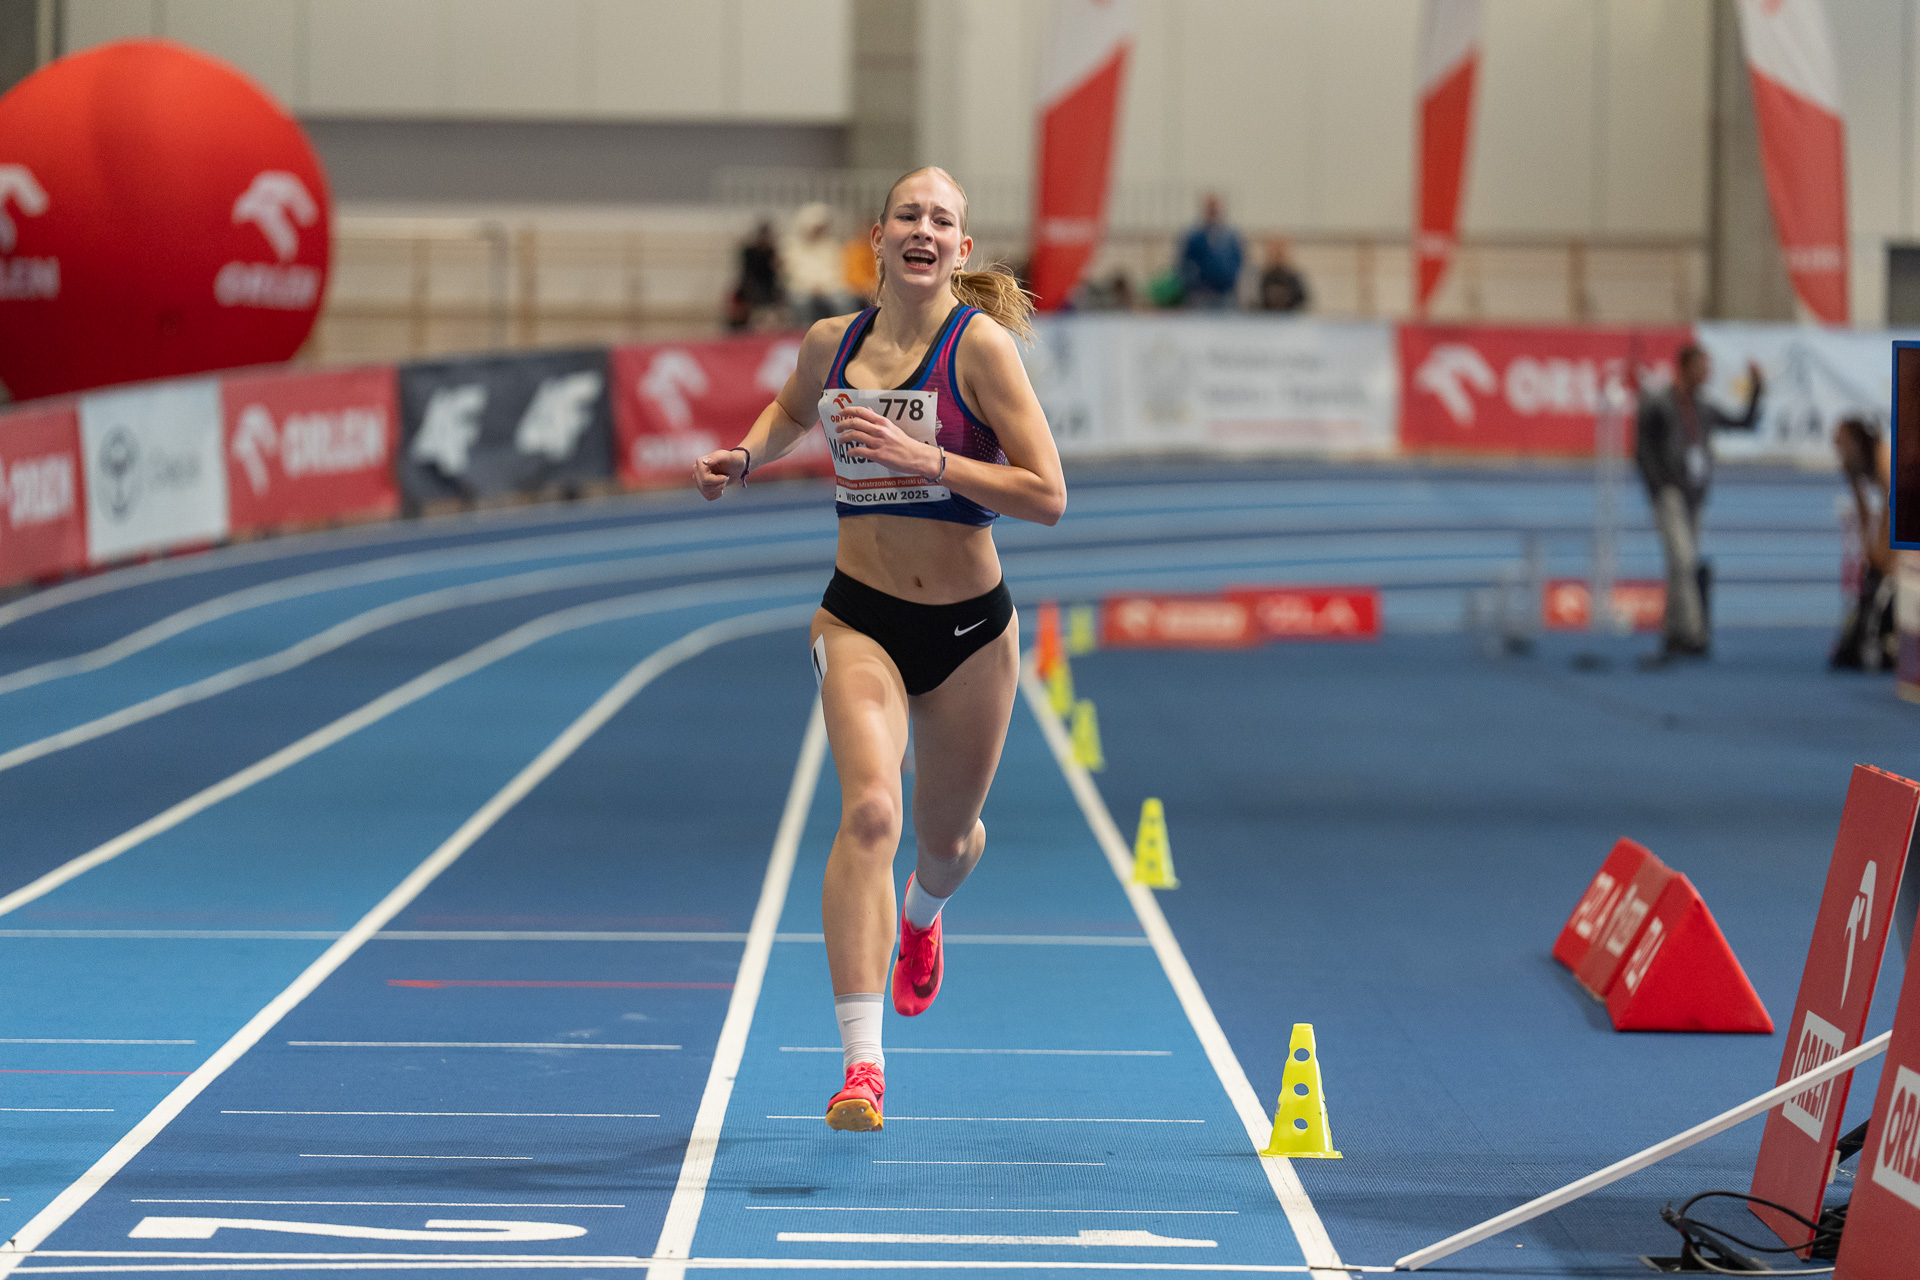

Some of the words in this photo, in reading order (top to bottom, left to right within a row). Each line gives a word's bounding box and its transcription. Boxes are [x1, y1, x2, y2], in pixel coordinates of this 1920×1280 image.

[879, 399, 924, 421] 778
[281, 408, 387, 477] ORLEN
[846, 492, 898, 502] WROCŁAW
[901, 490, 929, 500] 2025
[1790, 1029, 1839, 1122] ORLEN
[1883, 1086, 1920, 1184] ORL
[128, 1217, 587, 1241] 2
[776, 1229, 1218, 1247] 1
